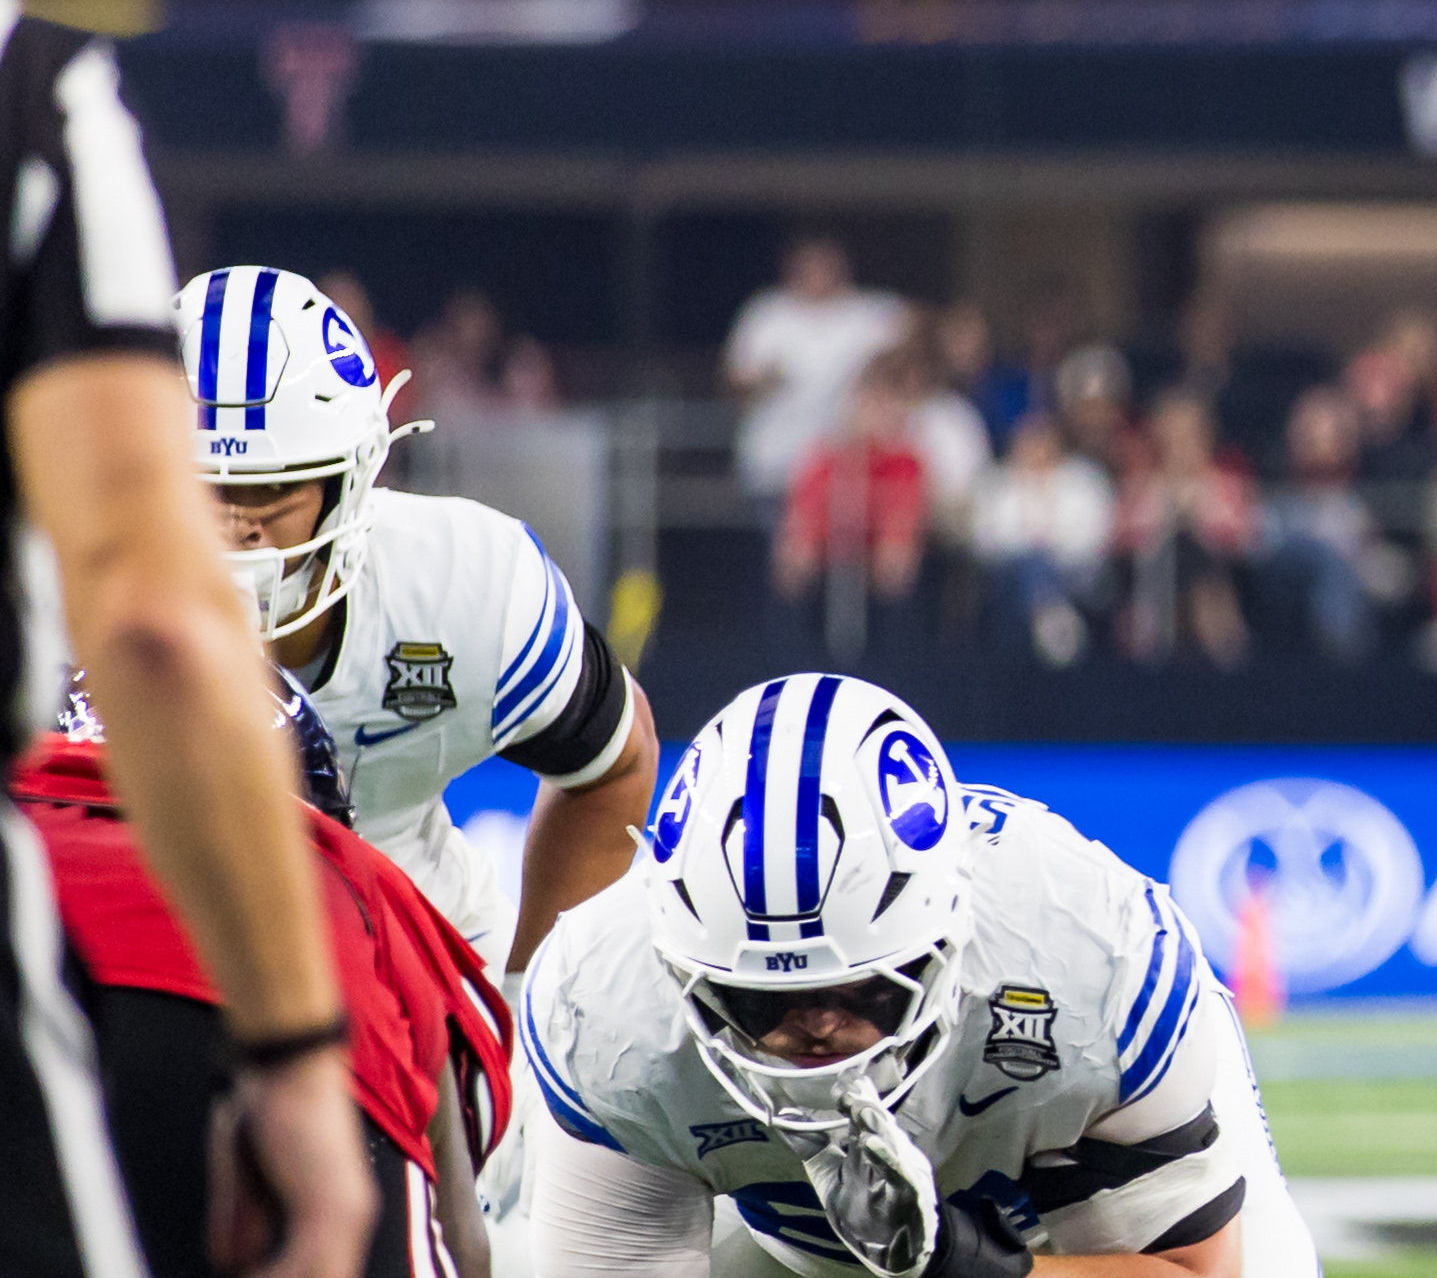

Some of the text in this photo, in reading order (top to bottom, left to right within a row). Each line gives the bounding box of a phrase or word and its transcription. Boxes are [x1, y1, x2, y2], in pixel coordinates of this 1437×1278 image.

[210, 437, 248, 457] BYU
[389, 659, 449, 691] XII
[765, 952, 808, 973] BYU
[992, 1007, 1052, 1046] XII
